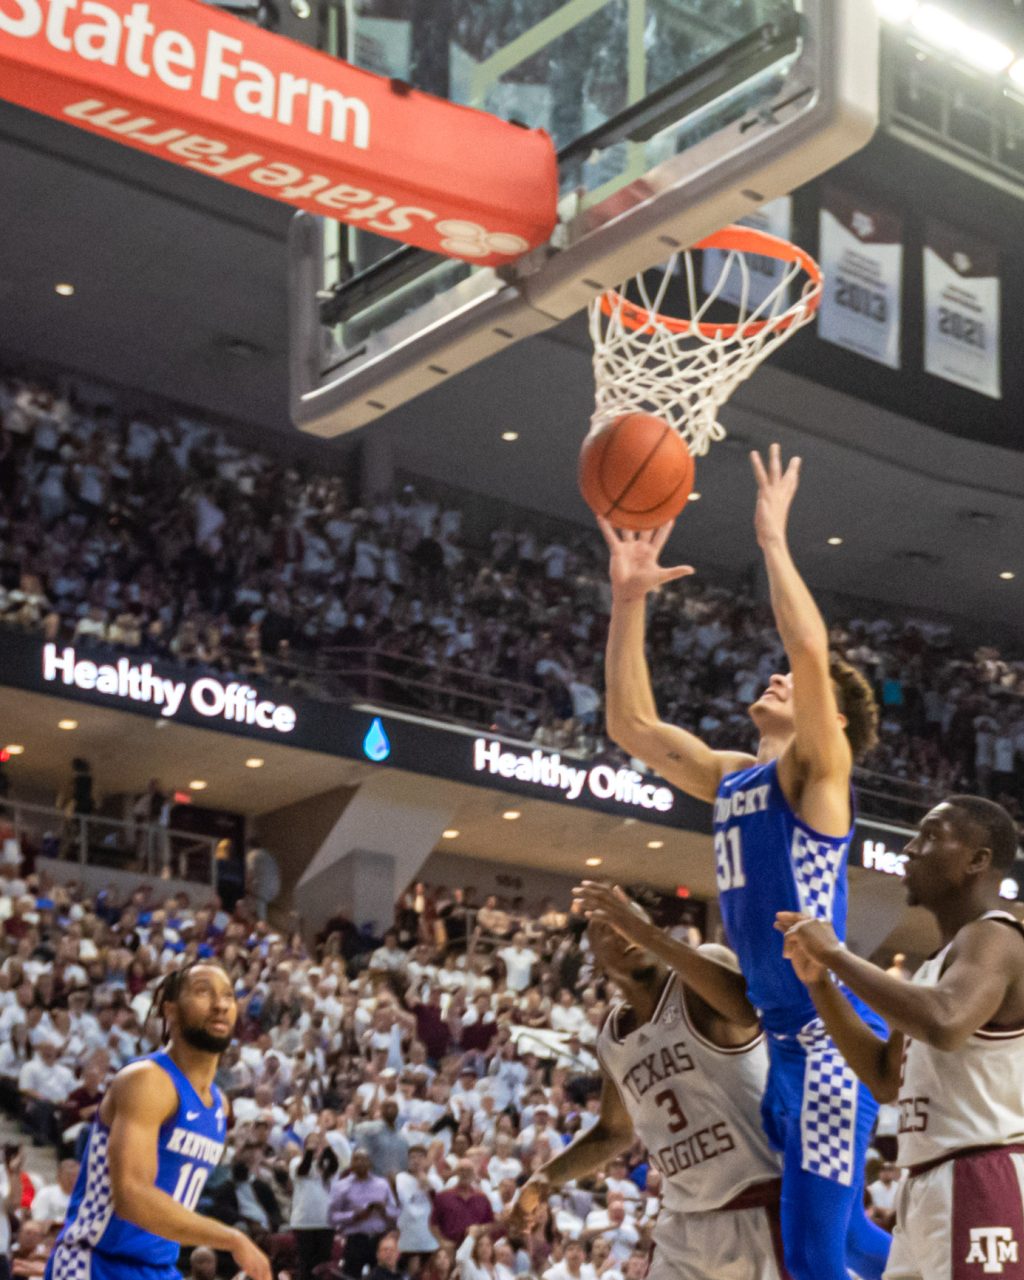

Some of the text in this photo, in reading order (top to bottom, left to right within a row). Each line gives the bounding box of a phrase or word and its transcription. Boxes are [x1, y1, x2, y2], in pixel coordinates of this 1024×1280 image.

[43, 643, 297, 732] Healthy Office
[474, 738, 674, 811] Healthy Office
[714, 826, 746, 890] 31
[622, 1041, 695, 1104] TEXAS
[654, 1089, 689, 1134] 3
[172, 1162, 208, 1213] 10
